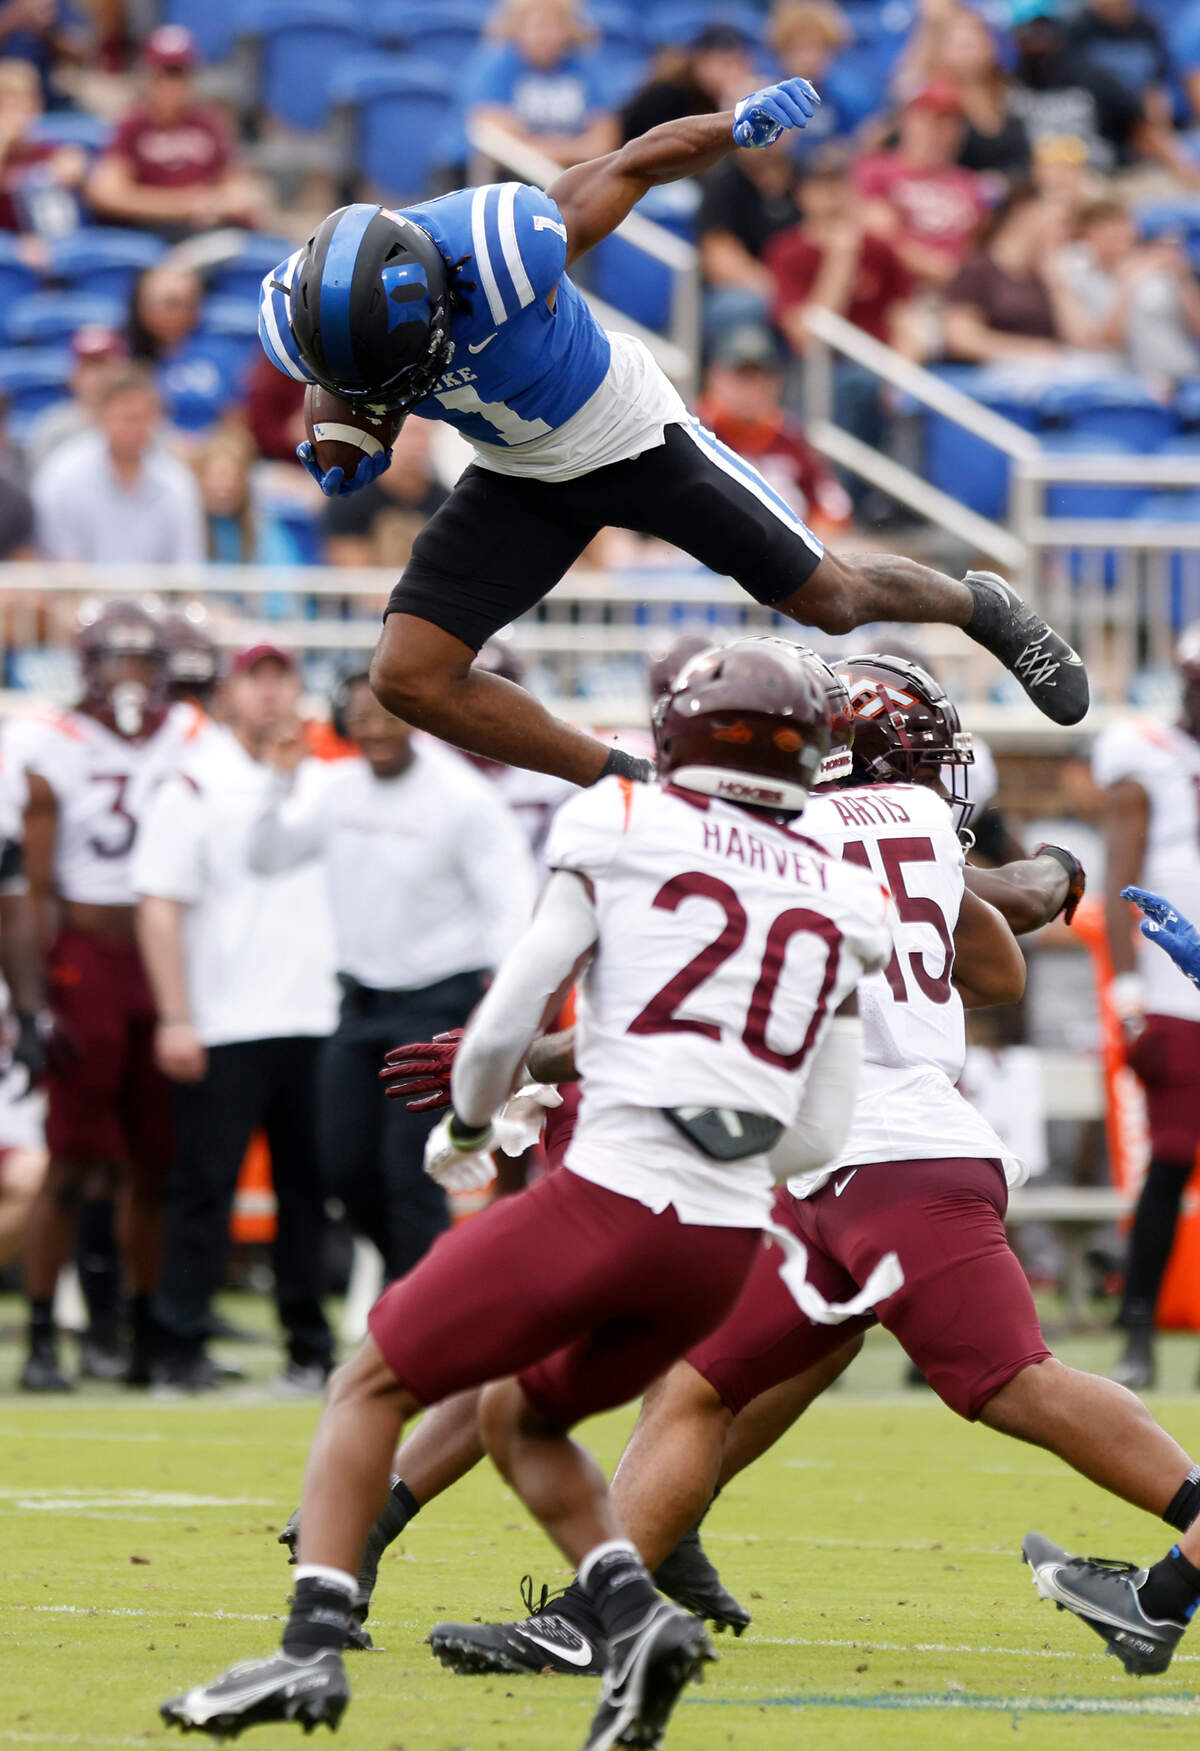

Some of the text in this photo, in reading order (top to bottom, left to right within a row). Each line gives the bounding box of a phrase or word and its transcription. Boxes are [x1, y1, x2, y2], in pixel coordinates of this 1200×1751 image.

[434, 384, 553, 446] 1
[87, 771, 139, 860] 3
[829, 795, 911, 827] ARTIS
[703, 821, 827, 891] HARVEY
[626, 871, 844, 1072] 20
